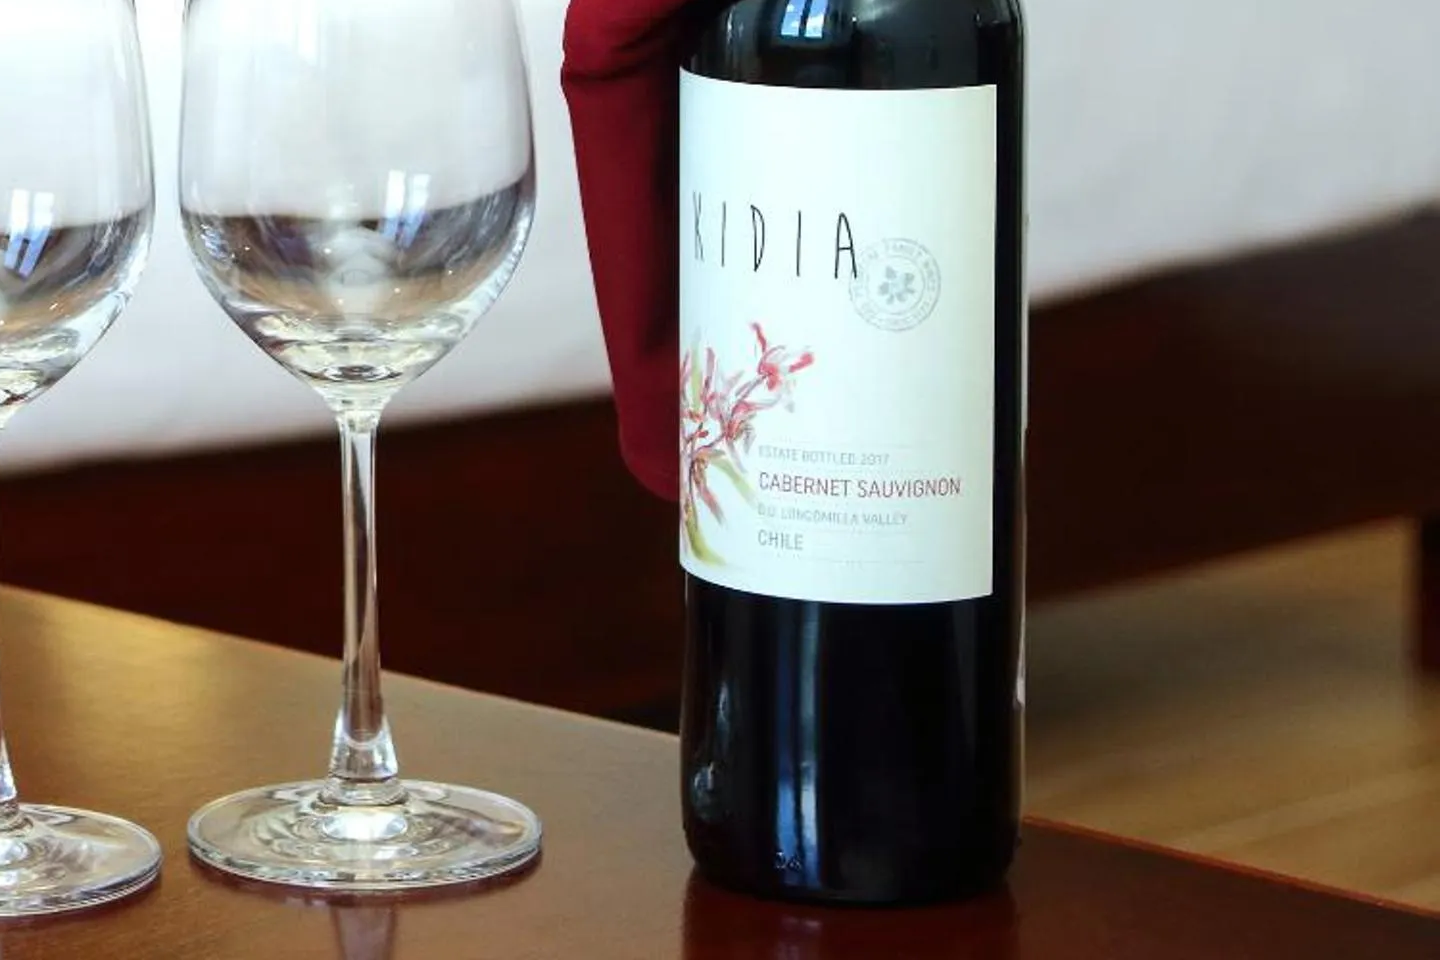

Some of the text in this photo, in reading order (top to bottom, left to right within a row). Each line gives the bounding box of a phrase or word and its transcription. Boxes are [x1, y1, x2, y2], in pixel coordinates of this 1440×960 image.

[692, 190, 858, 280] KIDIA
[758, 445, 799, 462] ESTATE
[801, 449, 856, 466] BOTTLED
[759, 471, 963, 499] CABERNET SAUVIGNON
[862, 512, 909, 526] VALLEY
[757, 529, 804, 552] CHILE
